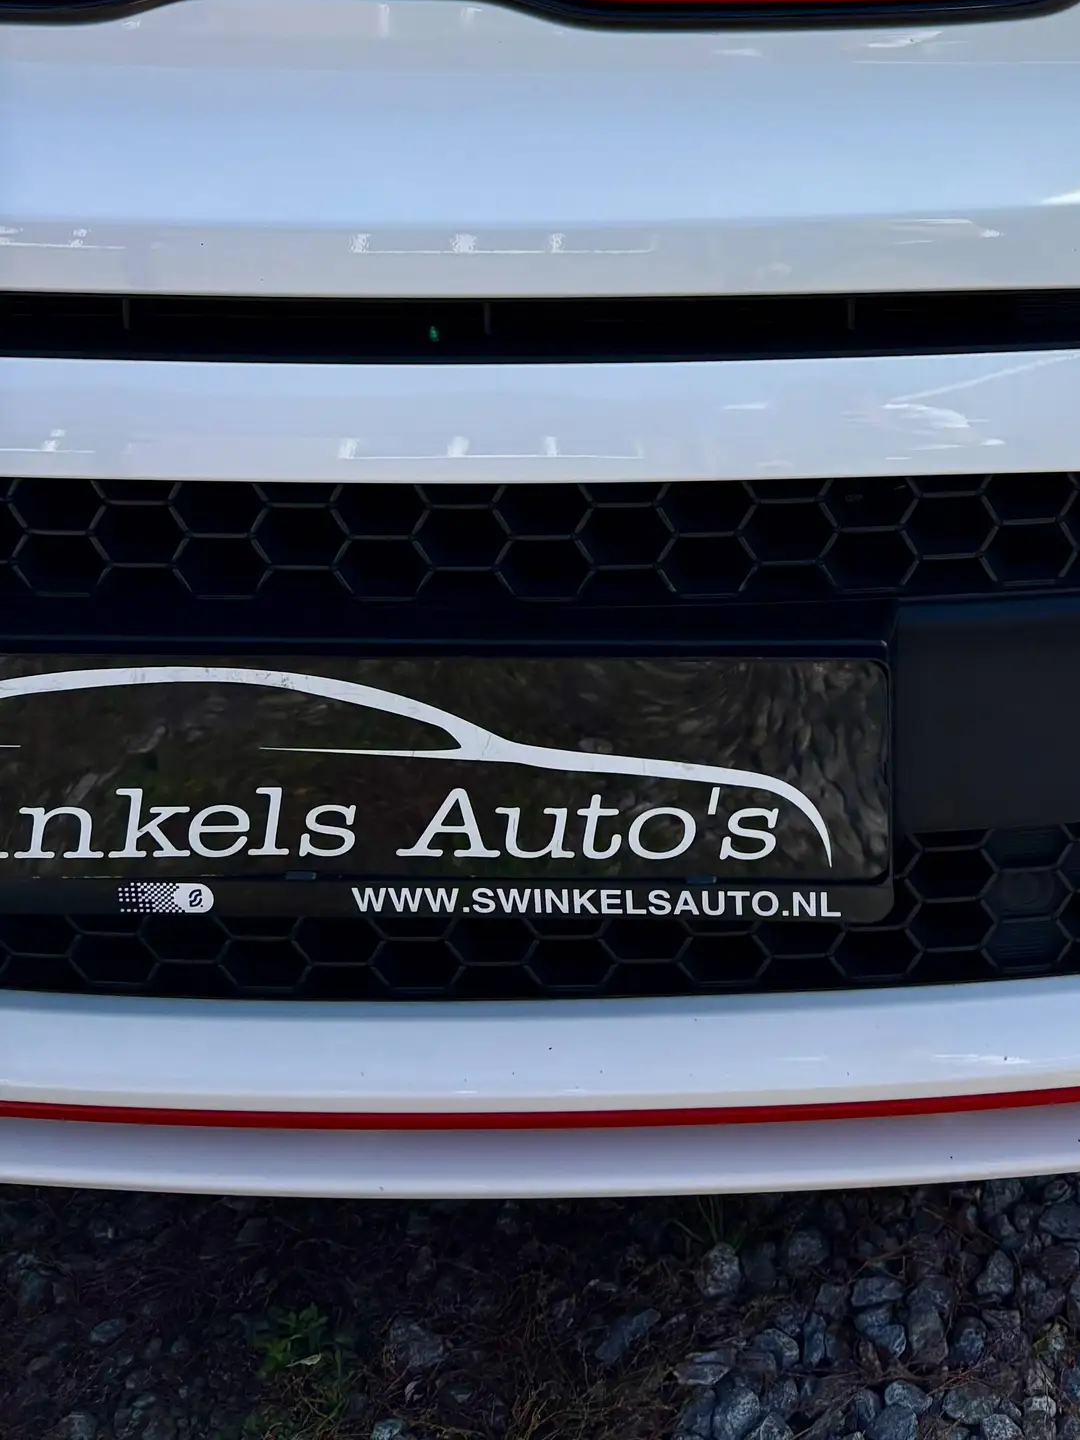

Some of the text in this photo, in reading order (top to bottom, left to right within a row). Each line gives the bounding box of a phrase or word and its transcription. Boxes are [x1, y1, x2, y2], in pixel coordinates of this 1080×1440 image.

[0, 787, 779, 860] nkels Auto's
[352, 887, 842, 918] WWW.SWINKELSAUTO.NL
